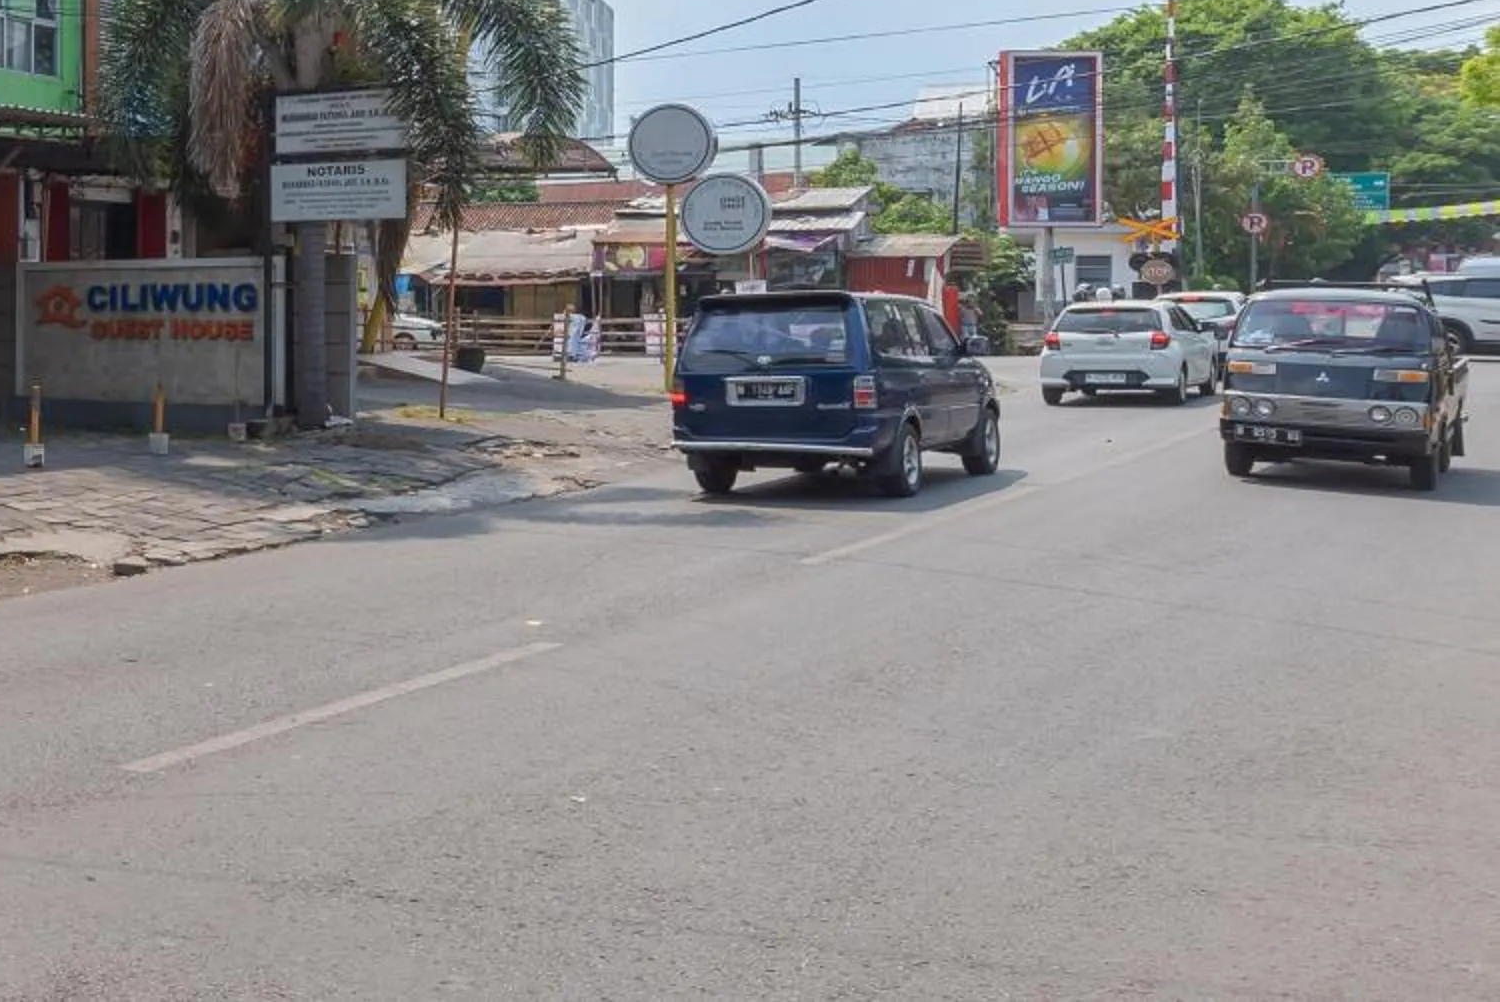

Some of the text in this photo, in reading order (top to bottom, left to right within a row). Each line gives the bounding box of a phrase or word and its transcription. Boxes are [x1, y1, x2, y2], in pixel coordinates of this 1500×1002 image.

[307, 164, 365, 178] NOTARIS
[1015, 173, 1061, 185] MANGO
[1021, 181, 1085, 194] SEASON!
[87, 283, 259, 313] CILIWUNG
[90, 320, 254, 342] GUEST HOUSE
